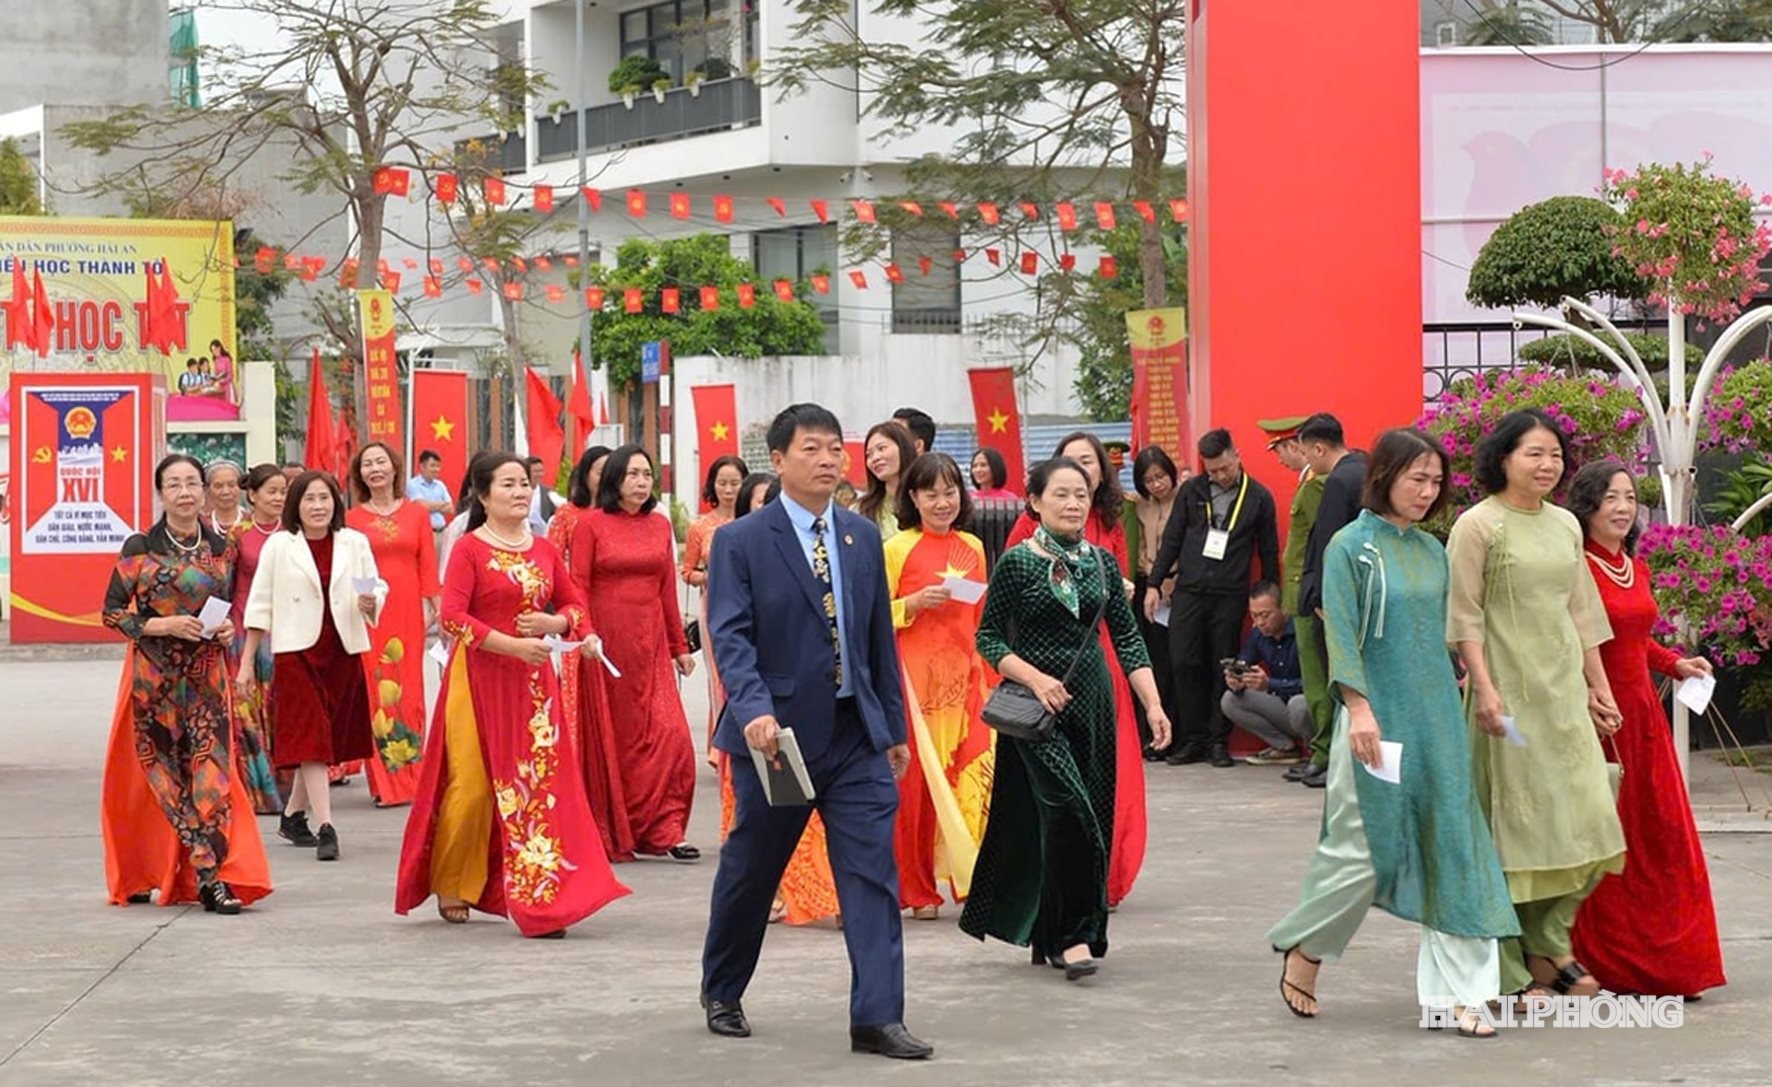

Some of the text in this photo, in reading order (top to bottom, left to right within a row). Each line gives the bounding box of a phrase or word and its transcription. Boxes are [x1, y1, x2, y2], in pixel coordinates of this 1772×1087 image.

[34, 259, 70, 277] HỌC
[56, 300, 124, 362] HỌC
[134, 302, 190, 351] TT
[62, 477, 99, 502] XVI
